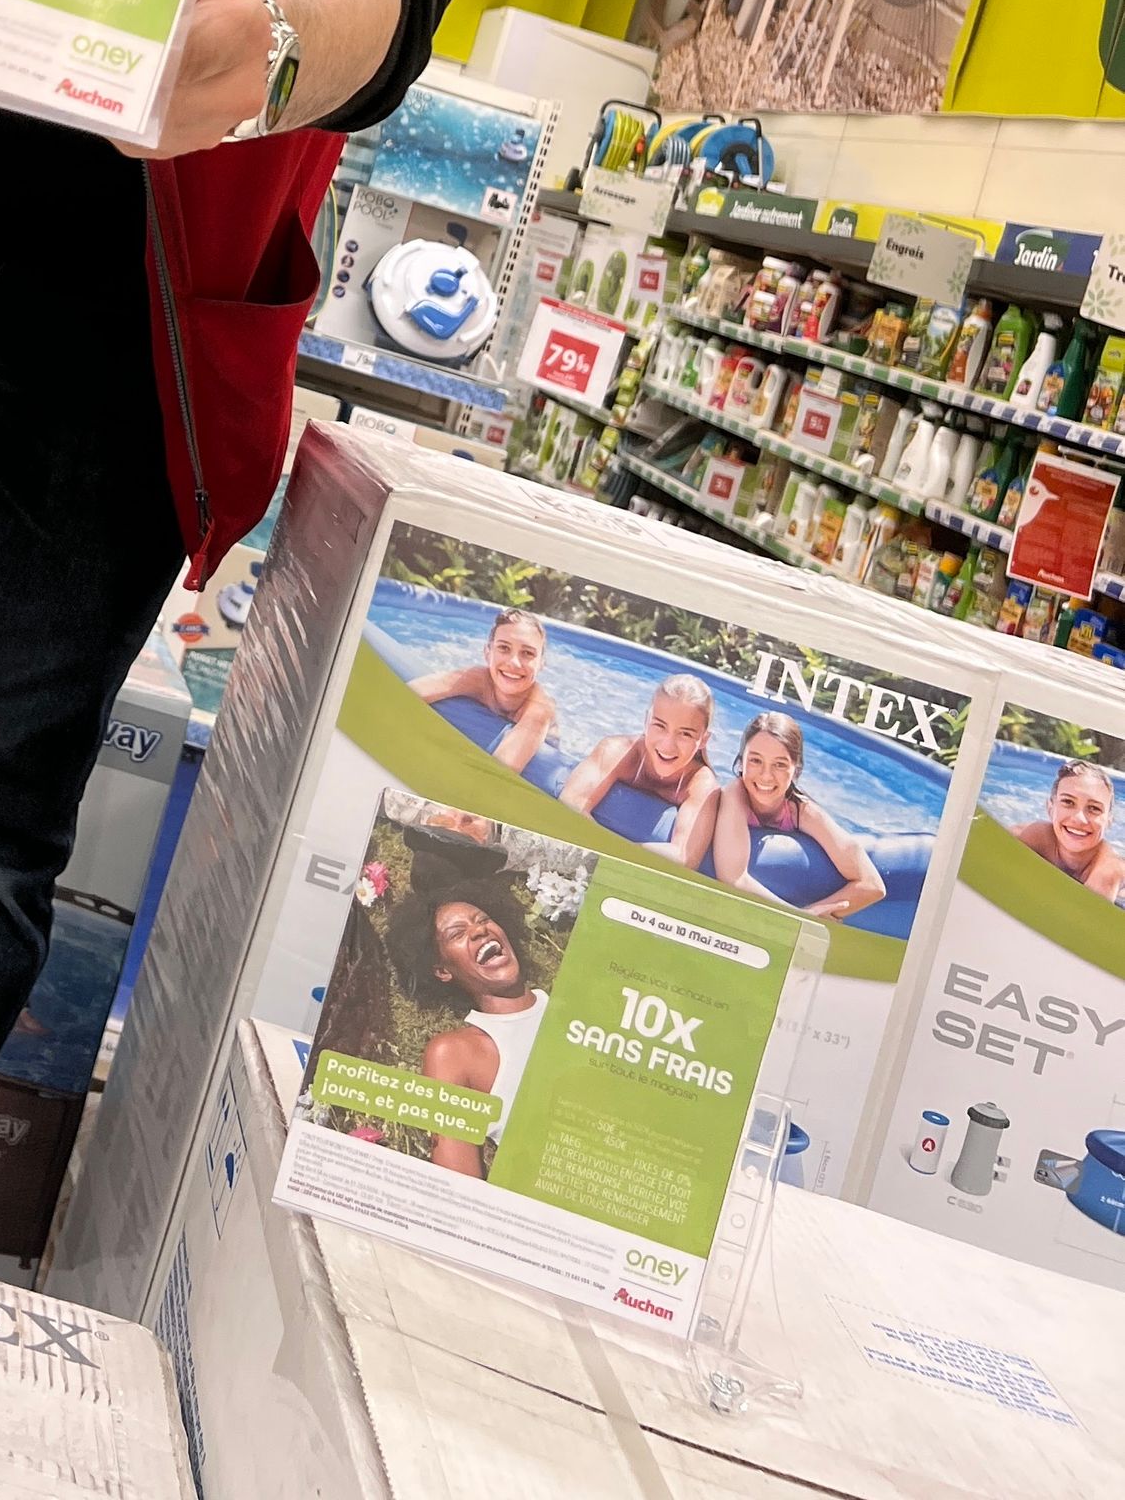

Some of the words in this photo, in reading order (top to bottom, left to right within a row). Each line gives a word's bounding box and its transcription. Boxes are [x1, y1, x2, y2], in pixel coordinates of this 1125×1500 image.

[72, 34, 144, 75] oney
[55, 77, 124, 114] Auchan
[593, 185, 636, 205] Arrosage
[885, 237, 924, 261] Engrais
[1014, 243, 1059, 271] Jardin
[746, 649, 954, 753] INTEX
[630, 910, 646, 924] Du
[648, 916, 656, 927] 4
[658, 921, 673, 933] au
[676, 925, 686, 937] 10
[688, 929, 712, 946] Mai
[713, 938, 740, 955] 2023
[620, 987, 704, 1053] 10X
[943, 962, 1125, 1047] EASY
[566, 1019, 643, 1064] SANS
[648, 1047, 734, 1095] FRAIS
[321, 1078, 371, 1106] jours,
[374, 1094, 395, 1110] et
[397, 1101, 430, 1118] pas
[433, 1109, 480, 1134] que...
[326, 1058, 400, 1089] Profitez
[403, 1079, 435, 1099] des
[438, 1087, 493, 1115] beaux
[545, 1141, 560, 1154] UN
[593, 1157, 619, 1176] VOUS
[620, 1167, 657, 1190] ENGAGE
[669, 1183, 692, 1200] DOIT
[586, 1181, 600, 1196] DE
[661, 1168, 674, 1181] DE
[534, 1178, 564, 1197] AVANT
[580, 1192, 605, 1211] VOUS
[625, 1249, 689, 1286] oney
[613, 1287, 674, 1322] Auchan
